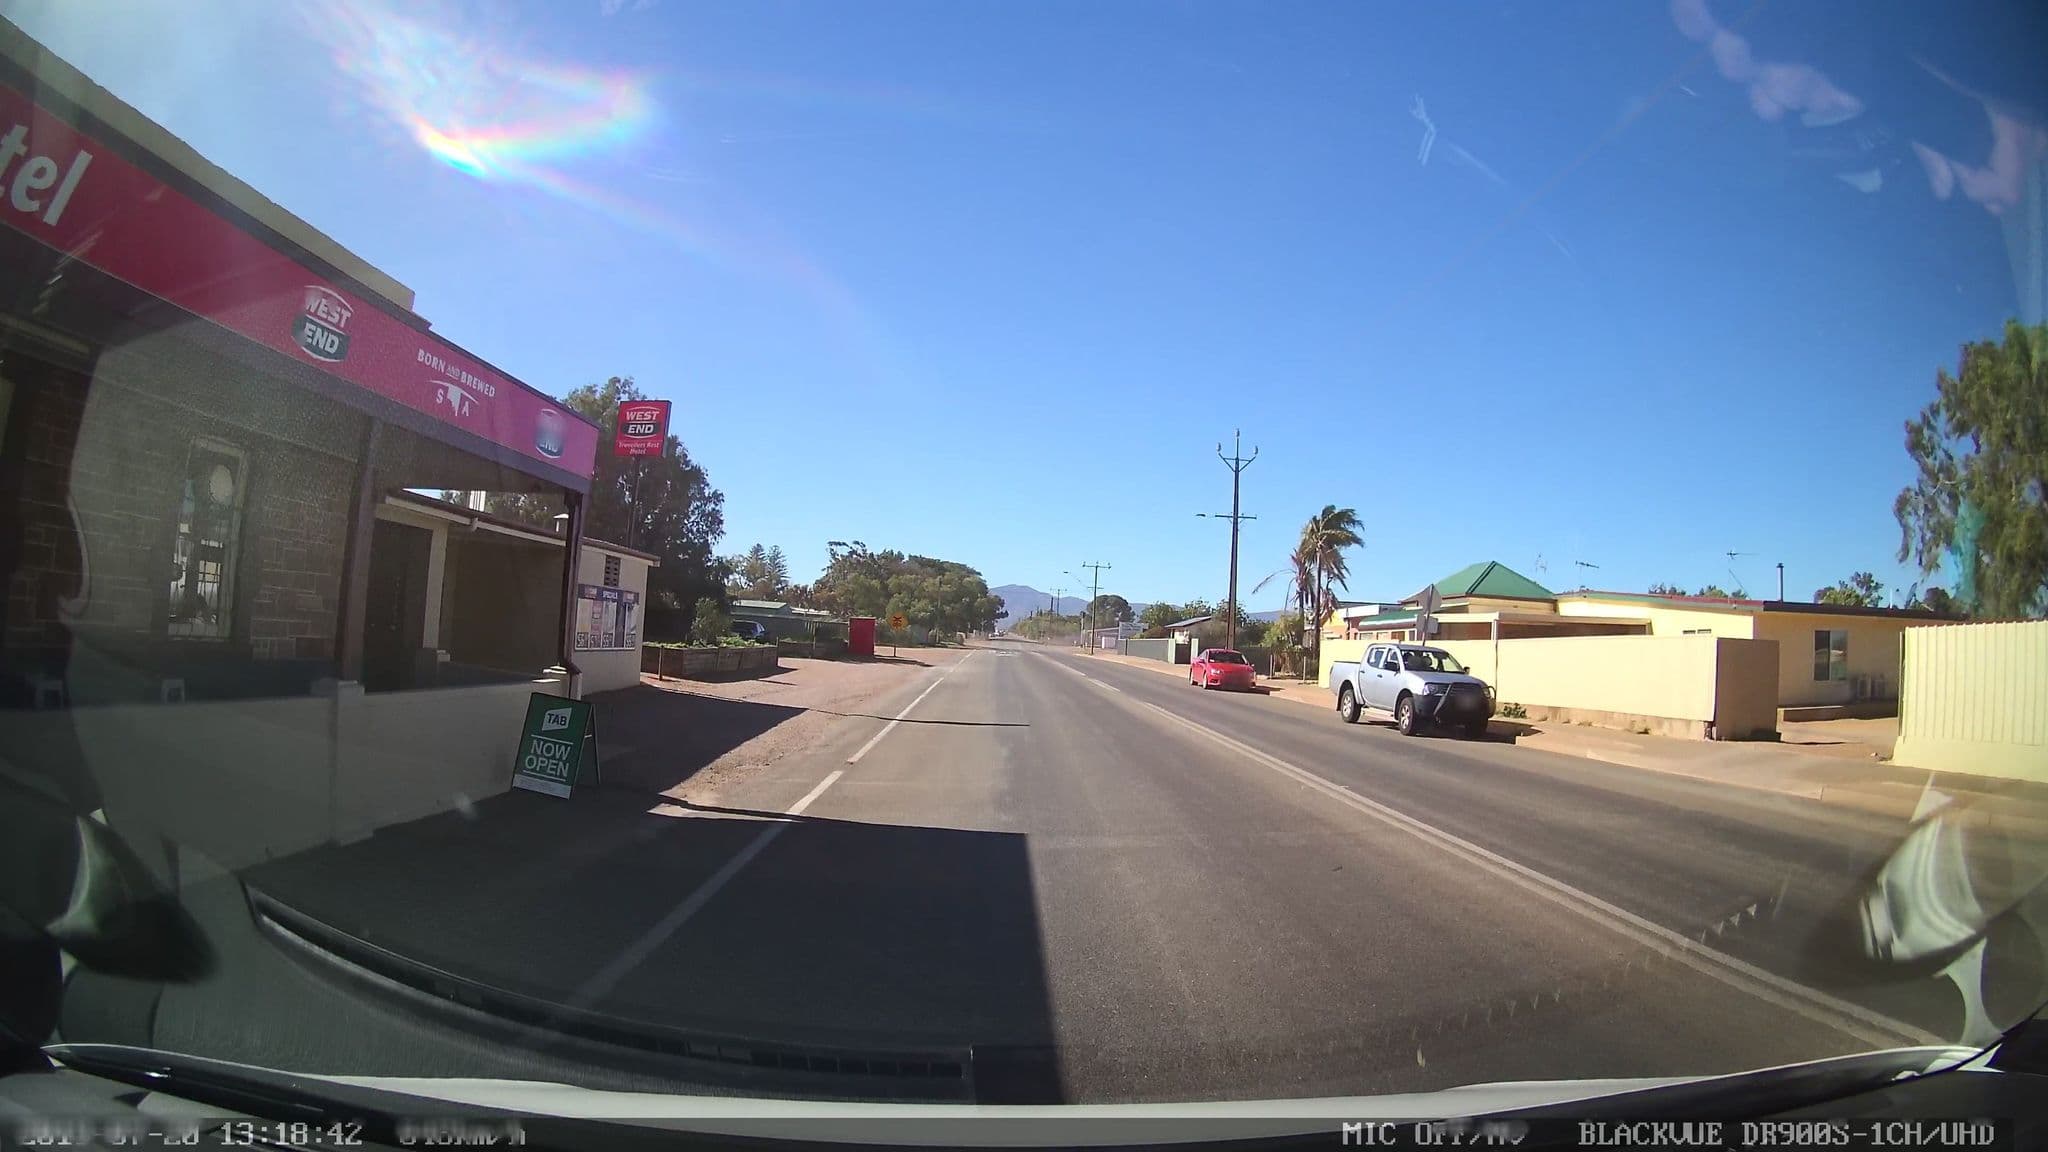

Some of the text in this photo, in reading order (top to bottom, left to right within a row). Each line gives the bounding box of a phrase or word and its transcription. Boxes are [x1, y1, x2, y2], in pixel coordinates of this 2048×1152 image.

[417, 348, 446, 373] BORN
[460, 372, 496, 397] BREWED
[626, 411, 660, 421] WEST
[627, 424, 654, 434] END
[547, 713, 567, 726] TAB
[531, 739, 571, 760] NOW
[525, 755, 569, 777] OPEN
